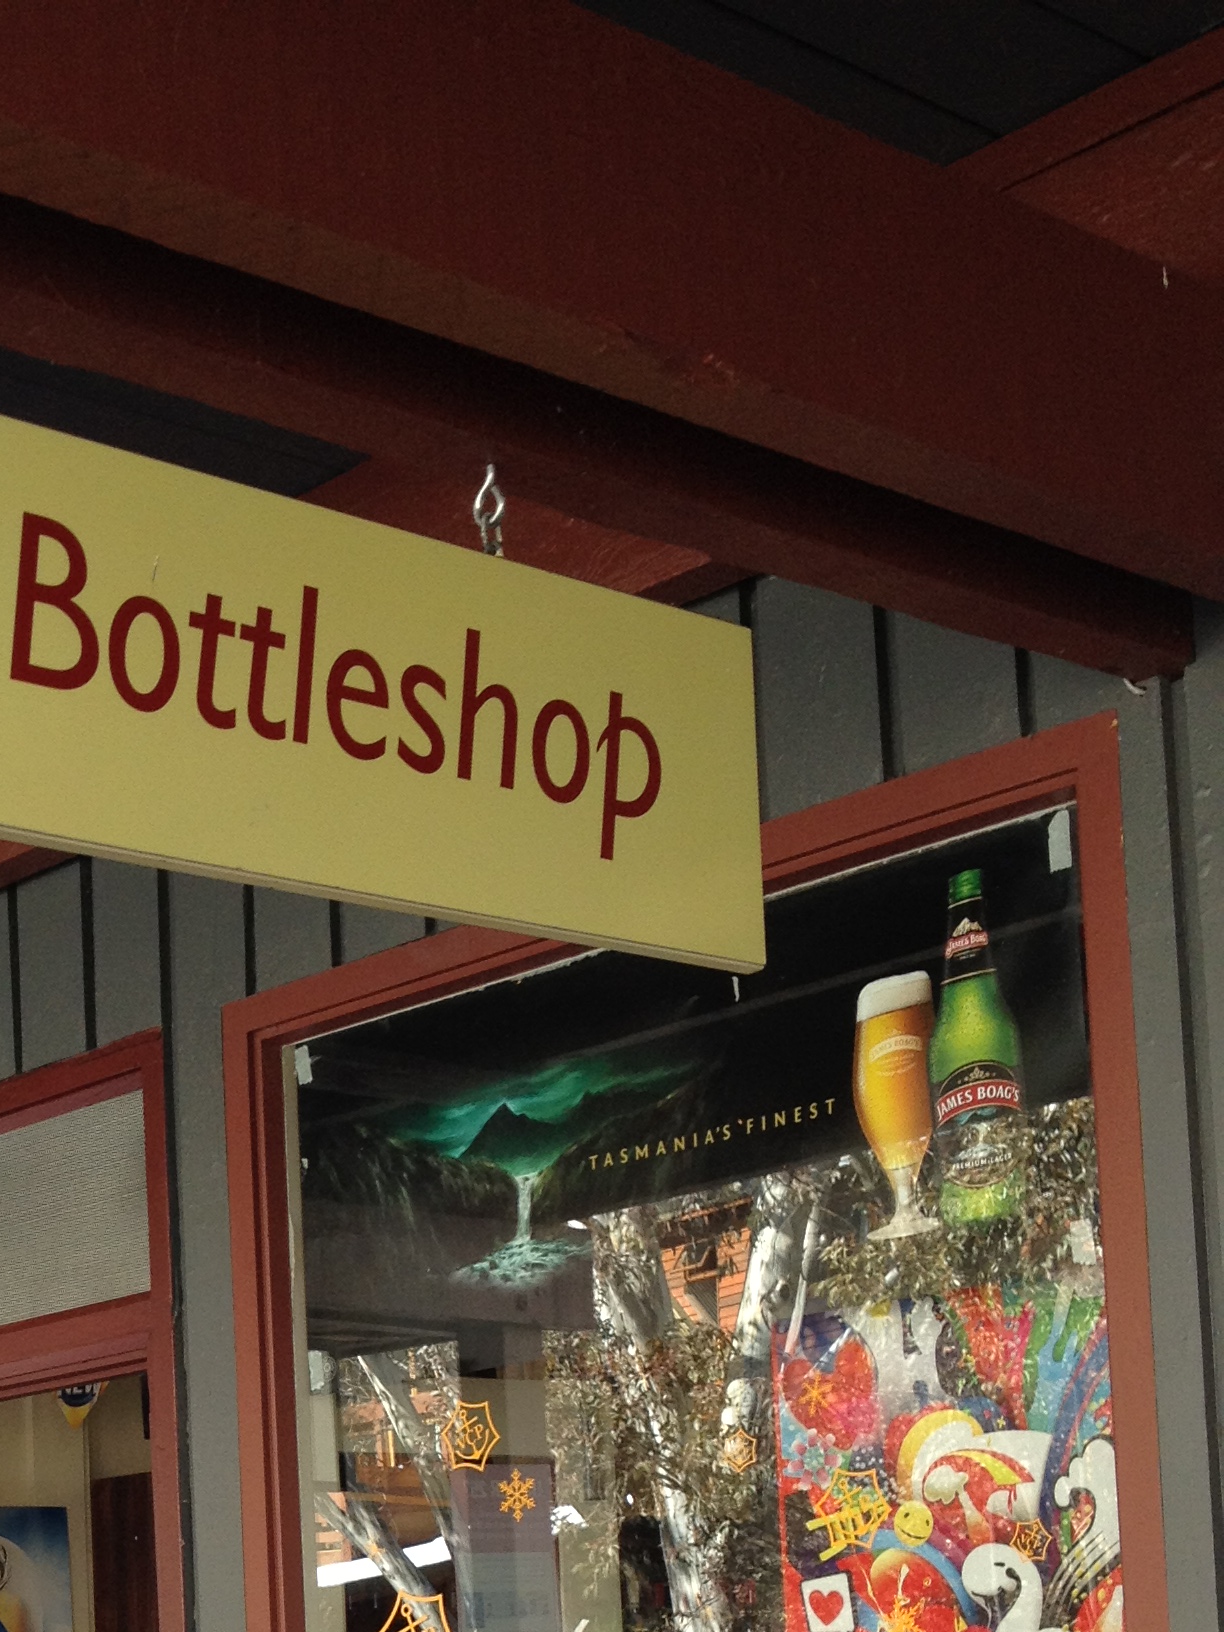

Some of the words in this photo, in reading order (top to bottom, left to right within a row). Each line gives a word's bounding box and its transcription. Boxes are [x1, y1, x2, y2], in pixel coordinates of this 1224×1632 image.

[9, 510, 663, 861] Bottleshop
[589, 1123, 732, 1171] TASMANIA'S
[745, 1097, 836, 1135] FINEST
[937, 1089, 973, 1121] JAMES
[977, 1085, 1020, 1102] BOAG'S
